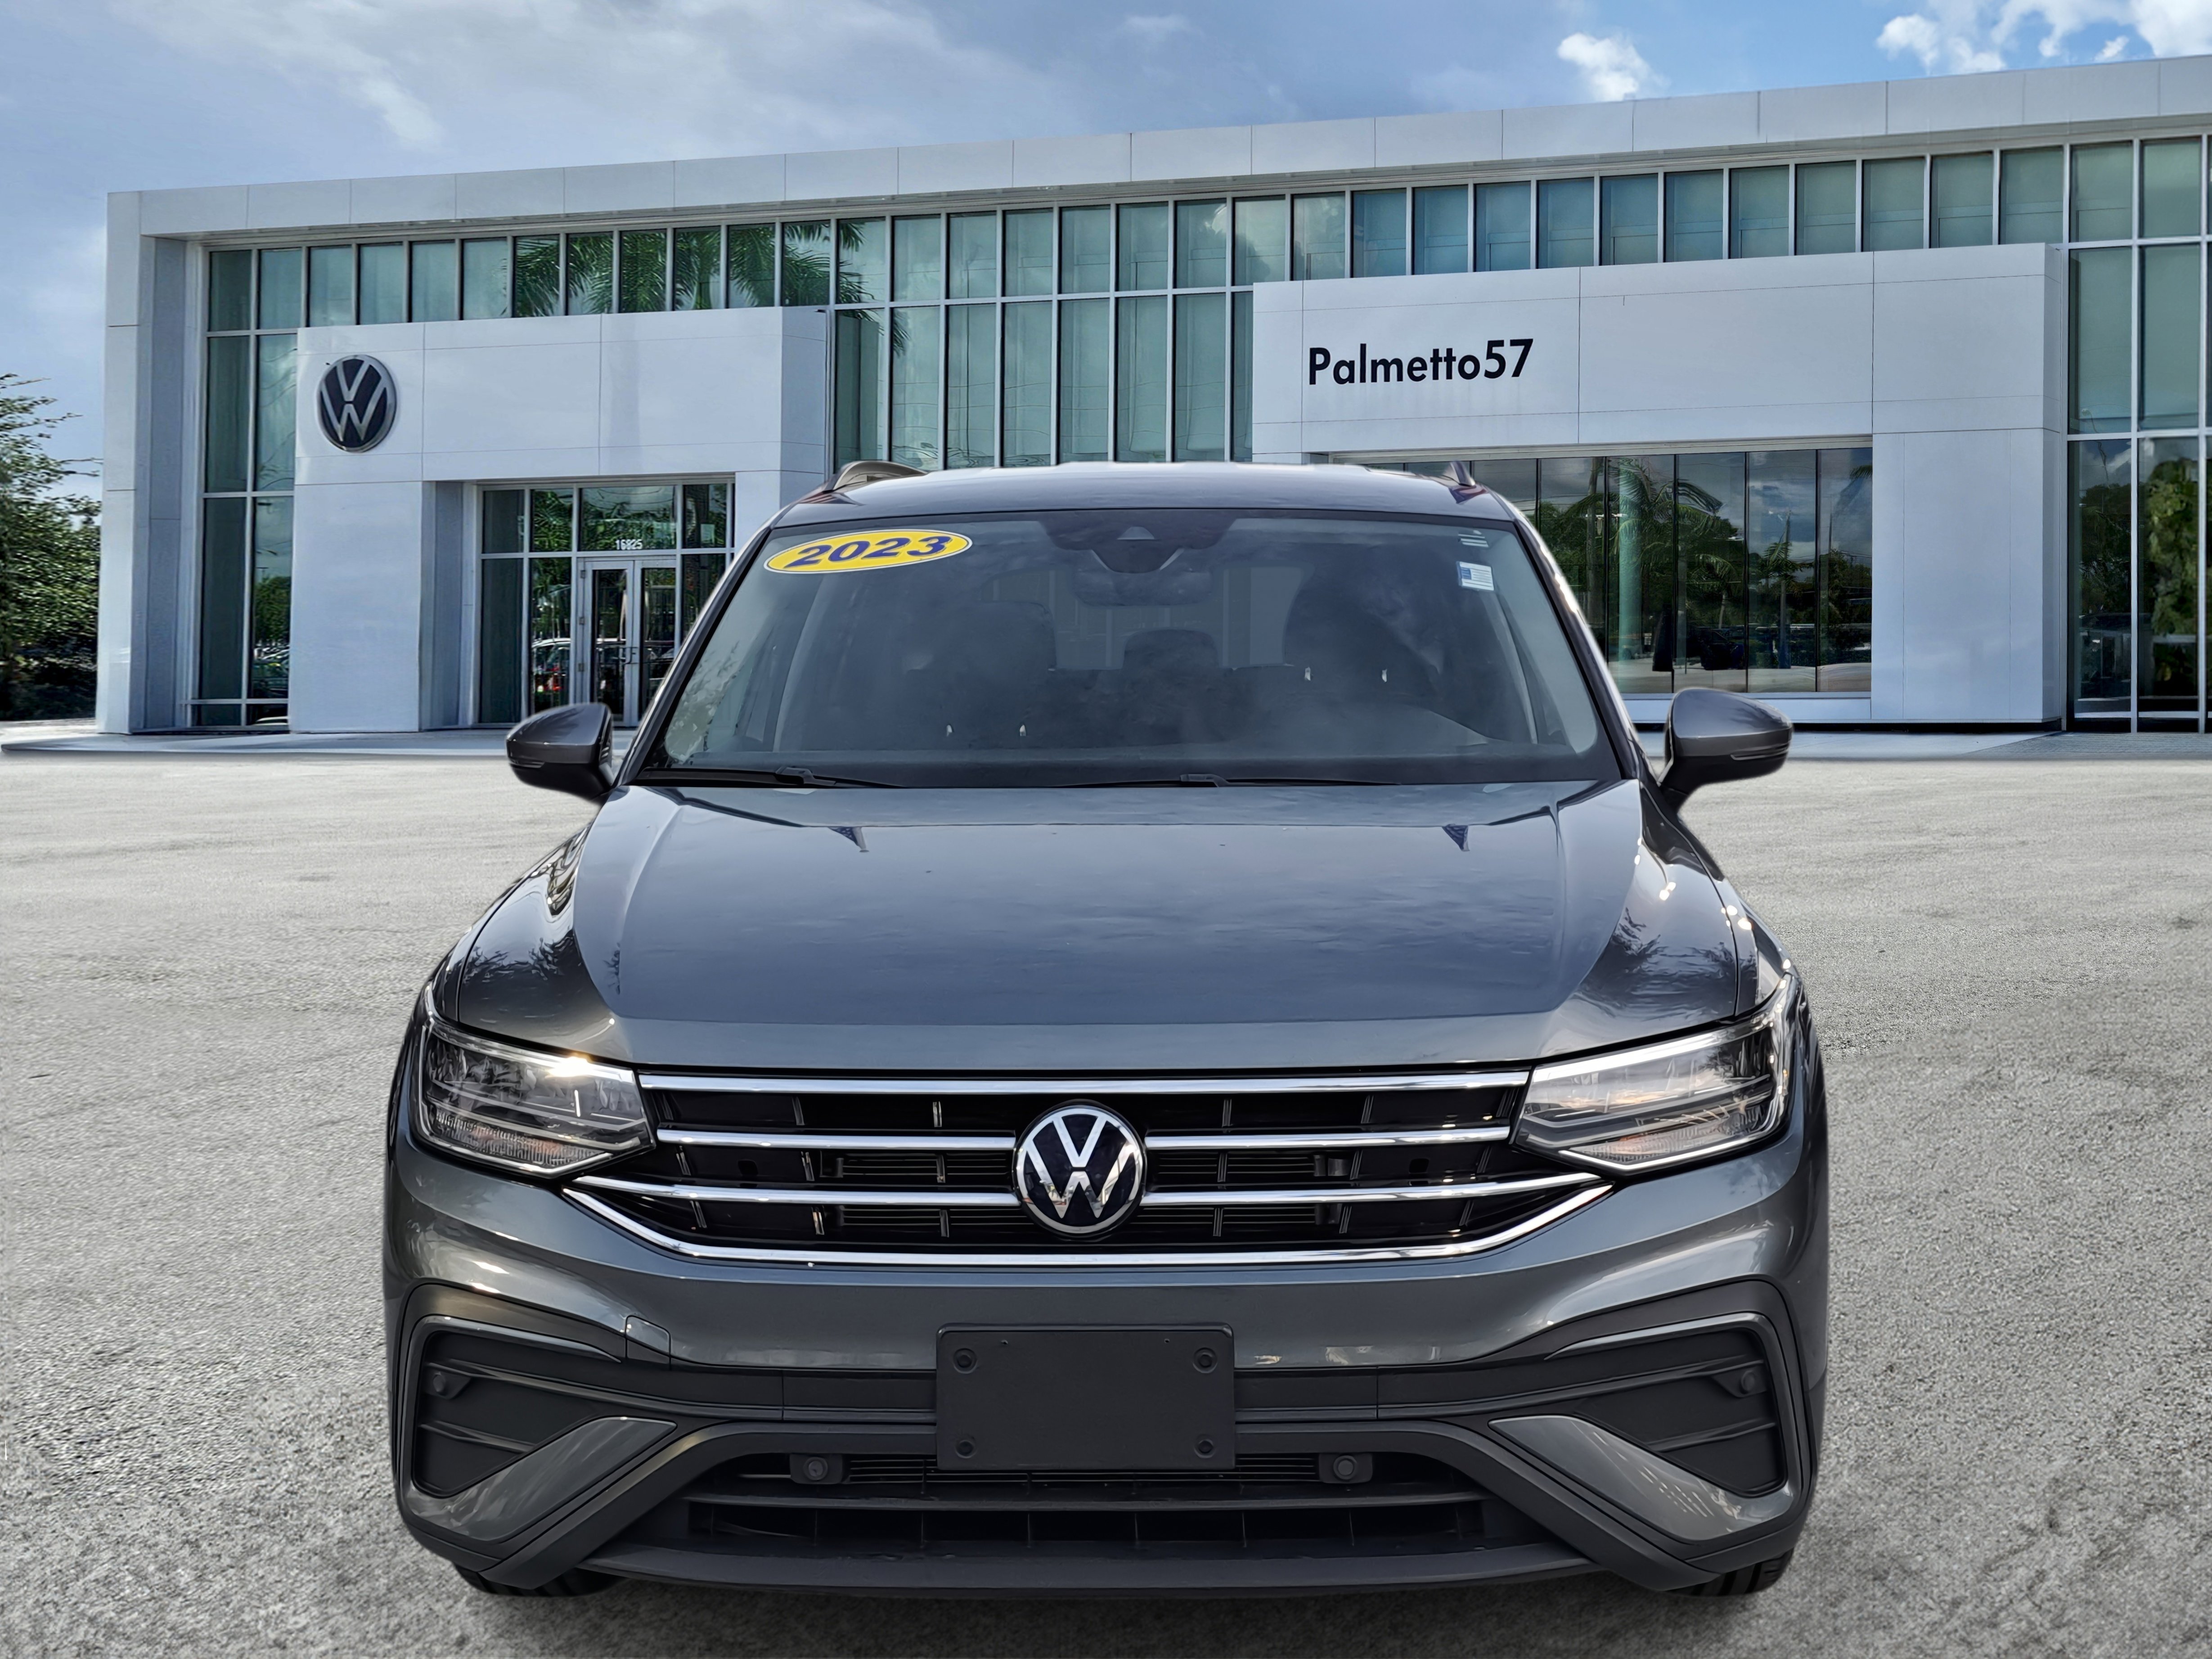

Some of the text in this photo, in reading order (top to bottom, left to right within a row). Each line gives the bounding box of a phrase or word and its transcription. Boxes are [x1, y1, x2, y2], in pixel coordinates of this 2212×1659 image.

[1309, 338, 1533, 385] Palmetto57
[319, 357, 386, 443] VW
[783, 535, 953, 569] 2023
[1021, 1111, 1137, 1219] VW
